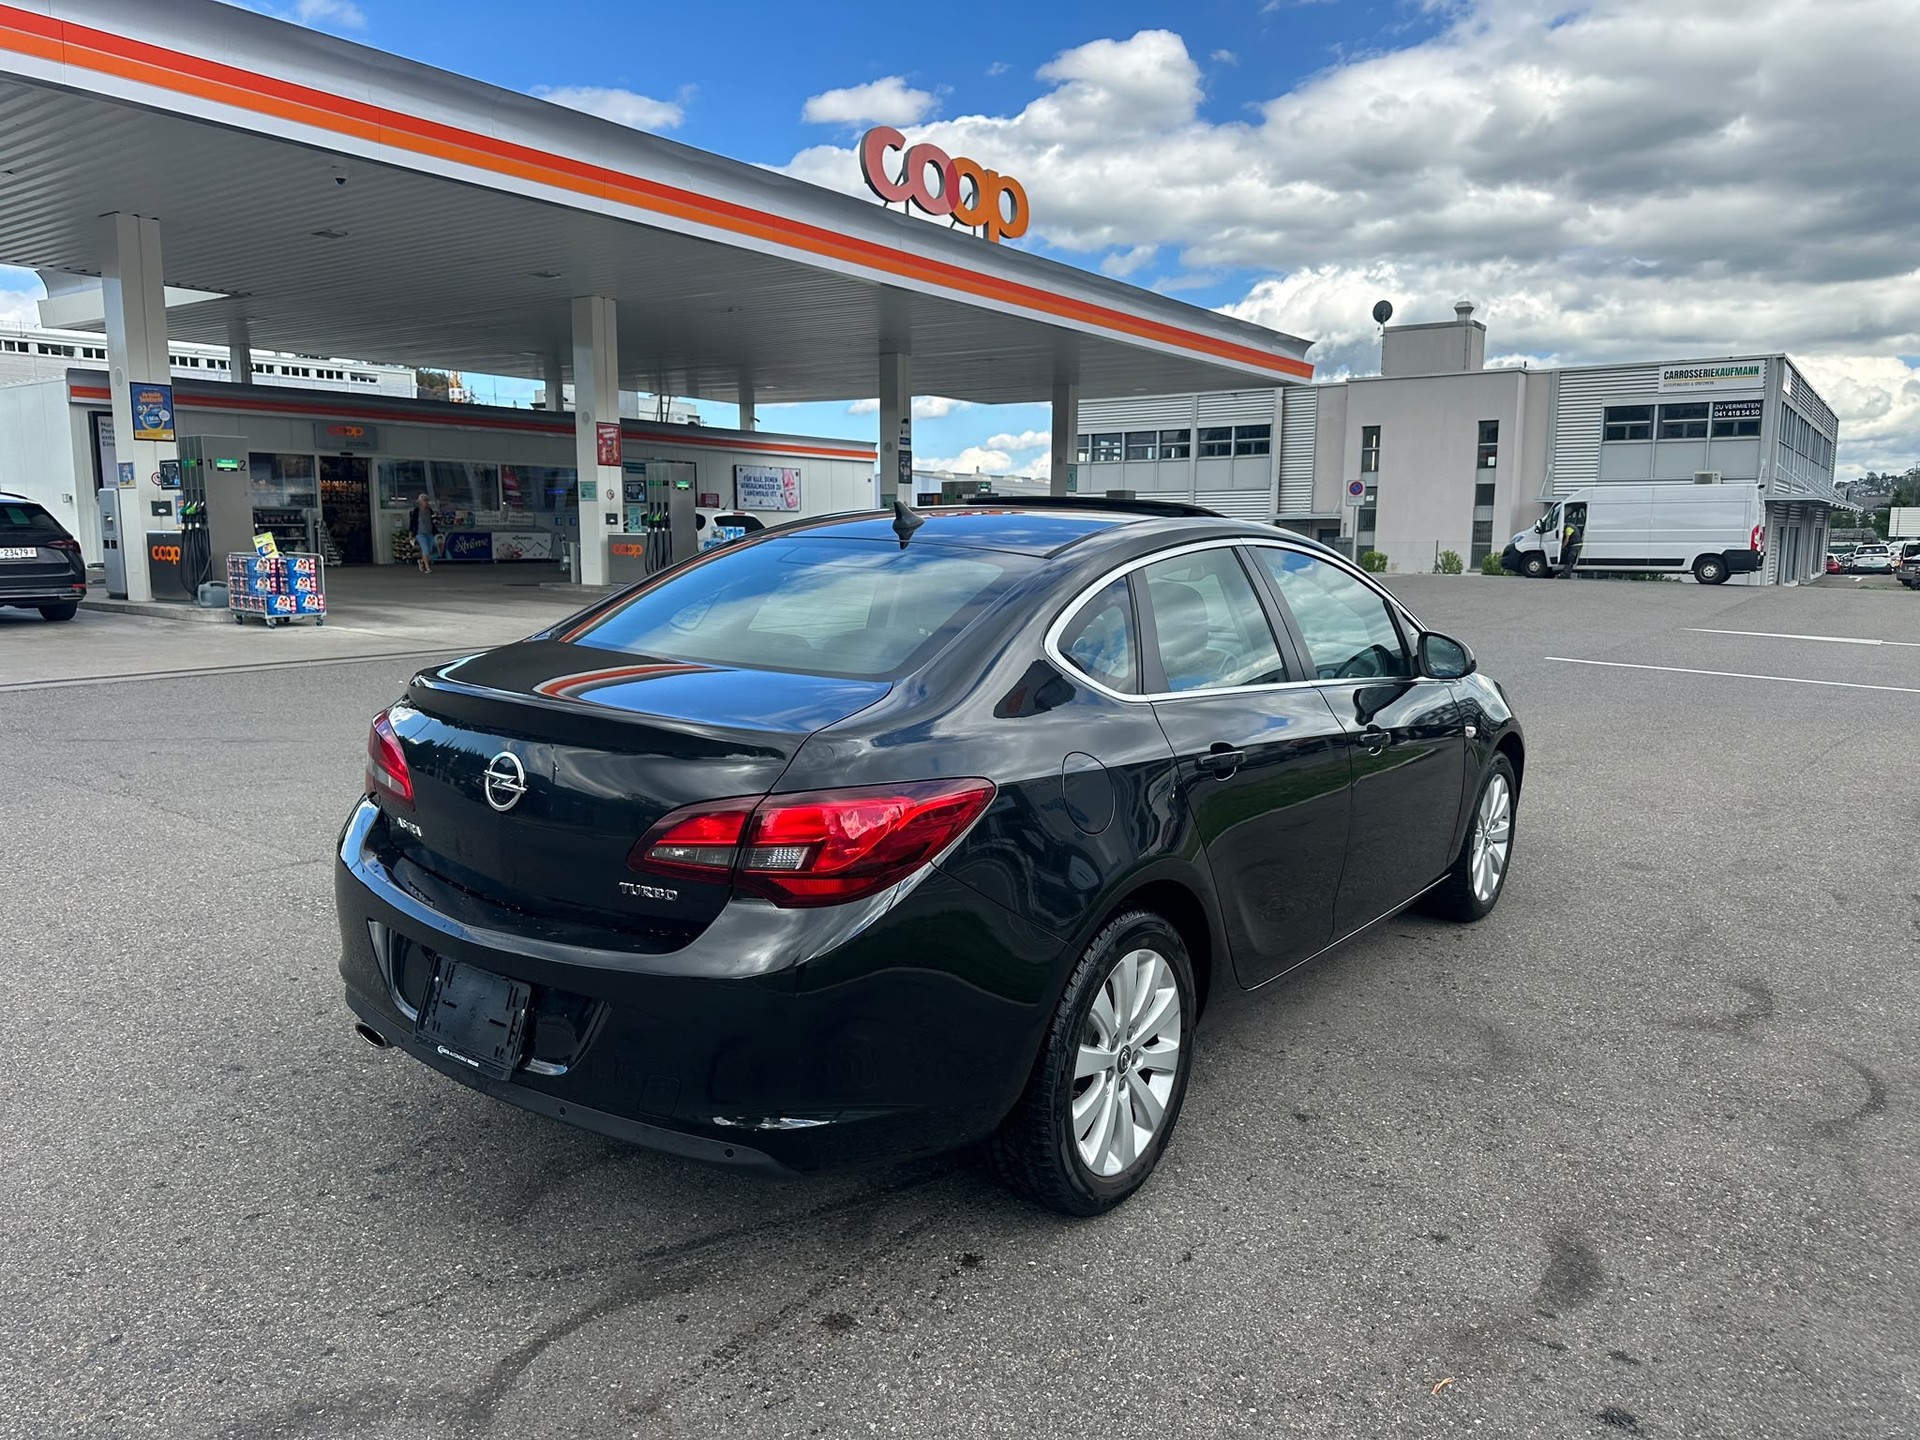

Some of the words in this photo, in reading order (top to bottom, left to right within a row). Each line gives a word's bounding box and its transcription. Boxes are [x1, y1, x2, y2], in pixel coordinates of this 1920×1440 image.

[1664, 366, 1759, 380] CARROSSERIEKAUFMANN
[1724, 402, 1760, 410] VERMIETEN
[207, 459, 213, 470] 1
[240, 460, 247, 471] 2
[618, 881, 678, 902] TURBO
